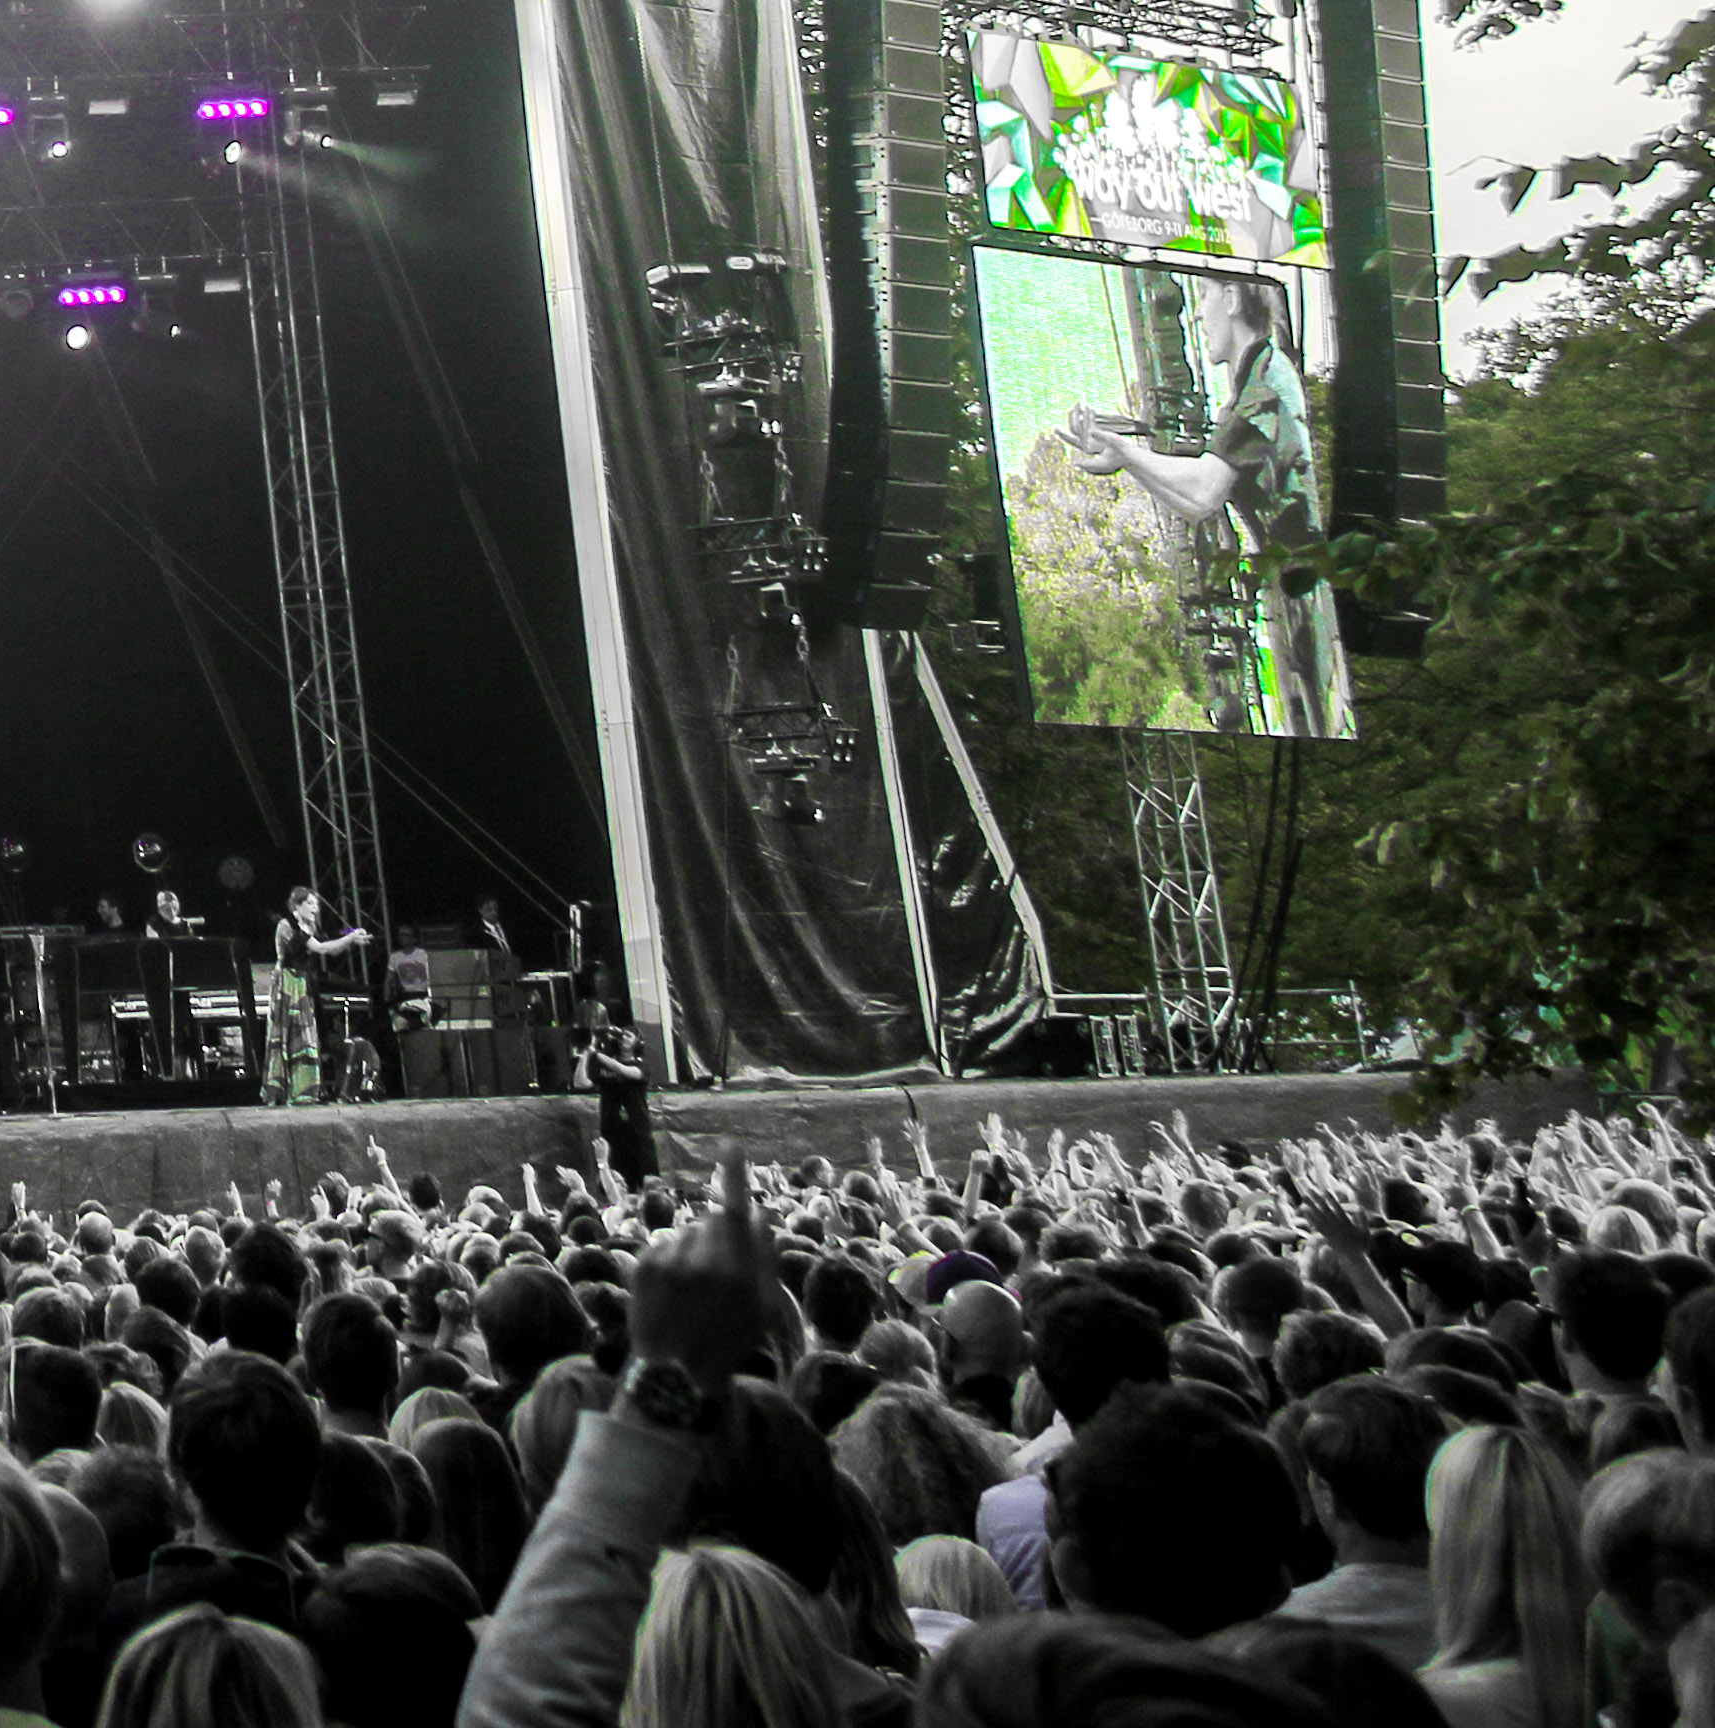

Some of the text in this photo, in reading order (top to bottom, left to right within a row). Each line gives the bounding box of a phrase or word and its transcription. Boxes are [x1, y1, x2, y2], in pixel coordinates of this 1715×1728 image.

[1134, 166, 1183, 213] out
[1182, 171, 1252, 222] west
[1101, 211, 1163, 236] GÖTEBORG
[1164, 220, 1183, 237] 9-11
